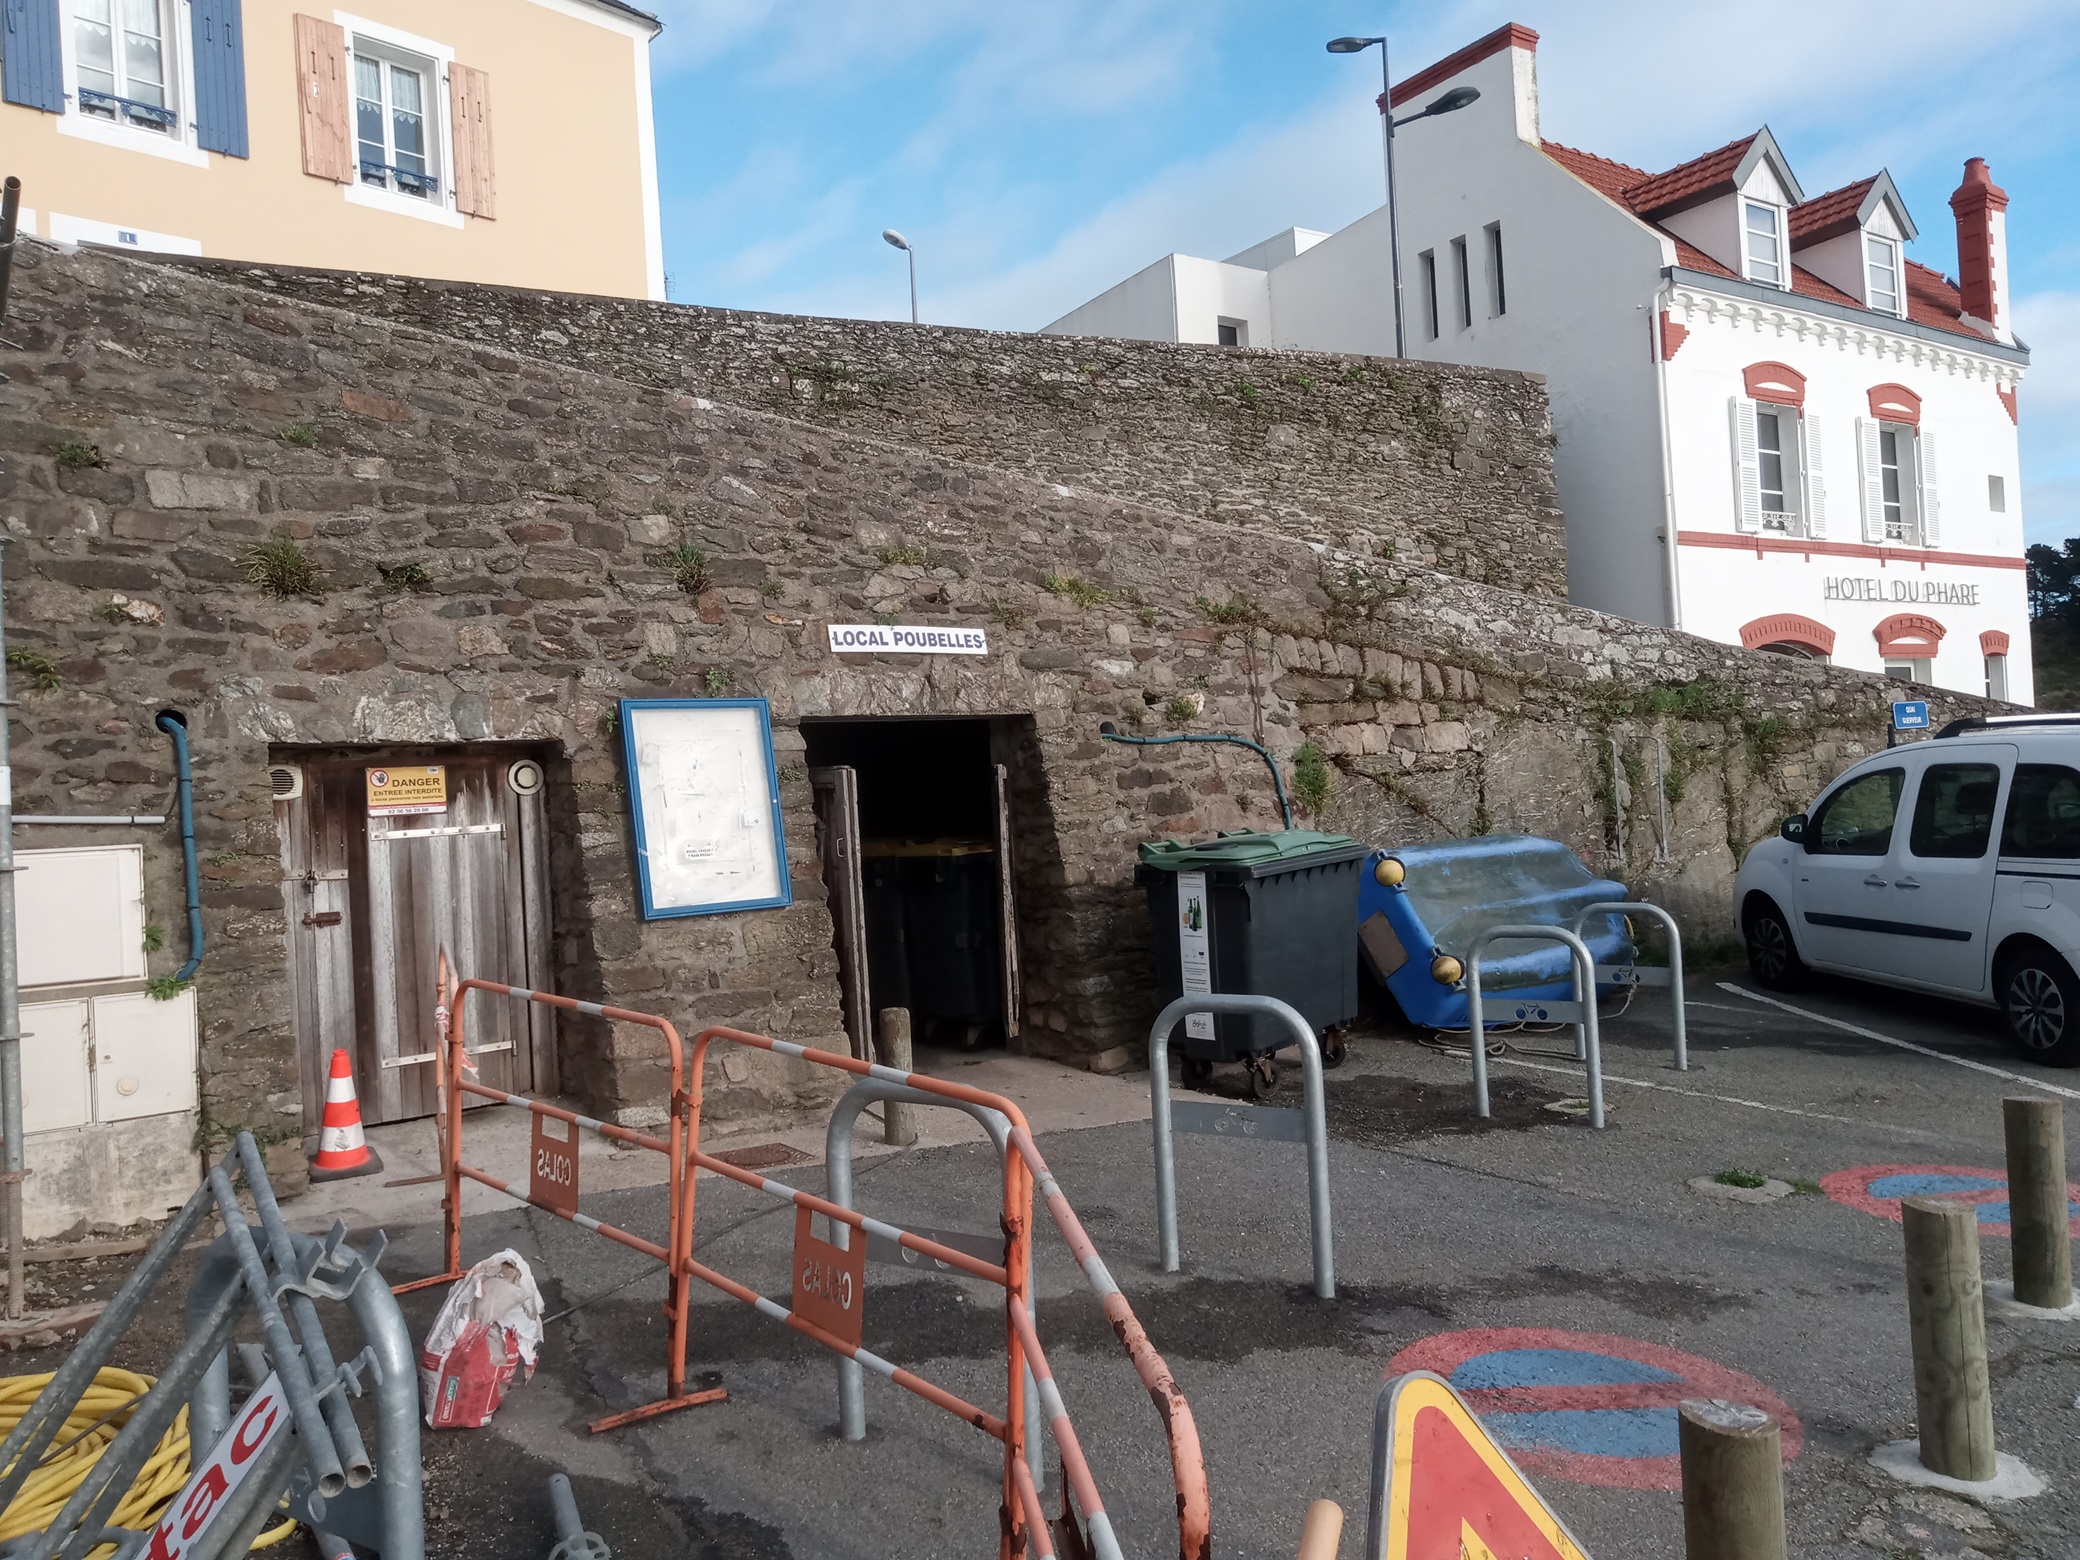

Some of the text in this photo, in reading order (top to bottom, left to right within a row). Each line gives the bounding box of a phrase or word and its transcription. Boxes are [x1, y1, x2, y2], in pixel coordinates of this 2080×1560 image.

[1824, 576, 1980, 605] HOTEL DU PHARE
[832, 630, 983, 649] LOCAL POUBELLES
[392, 778, 440, 787] DANGER
